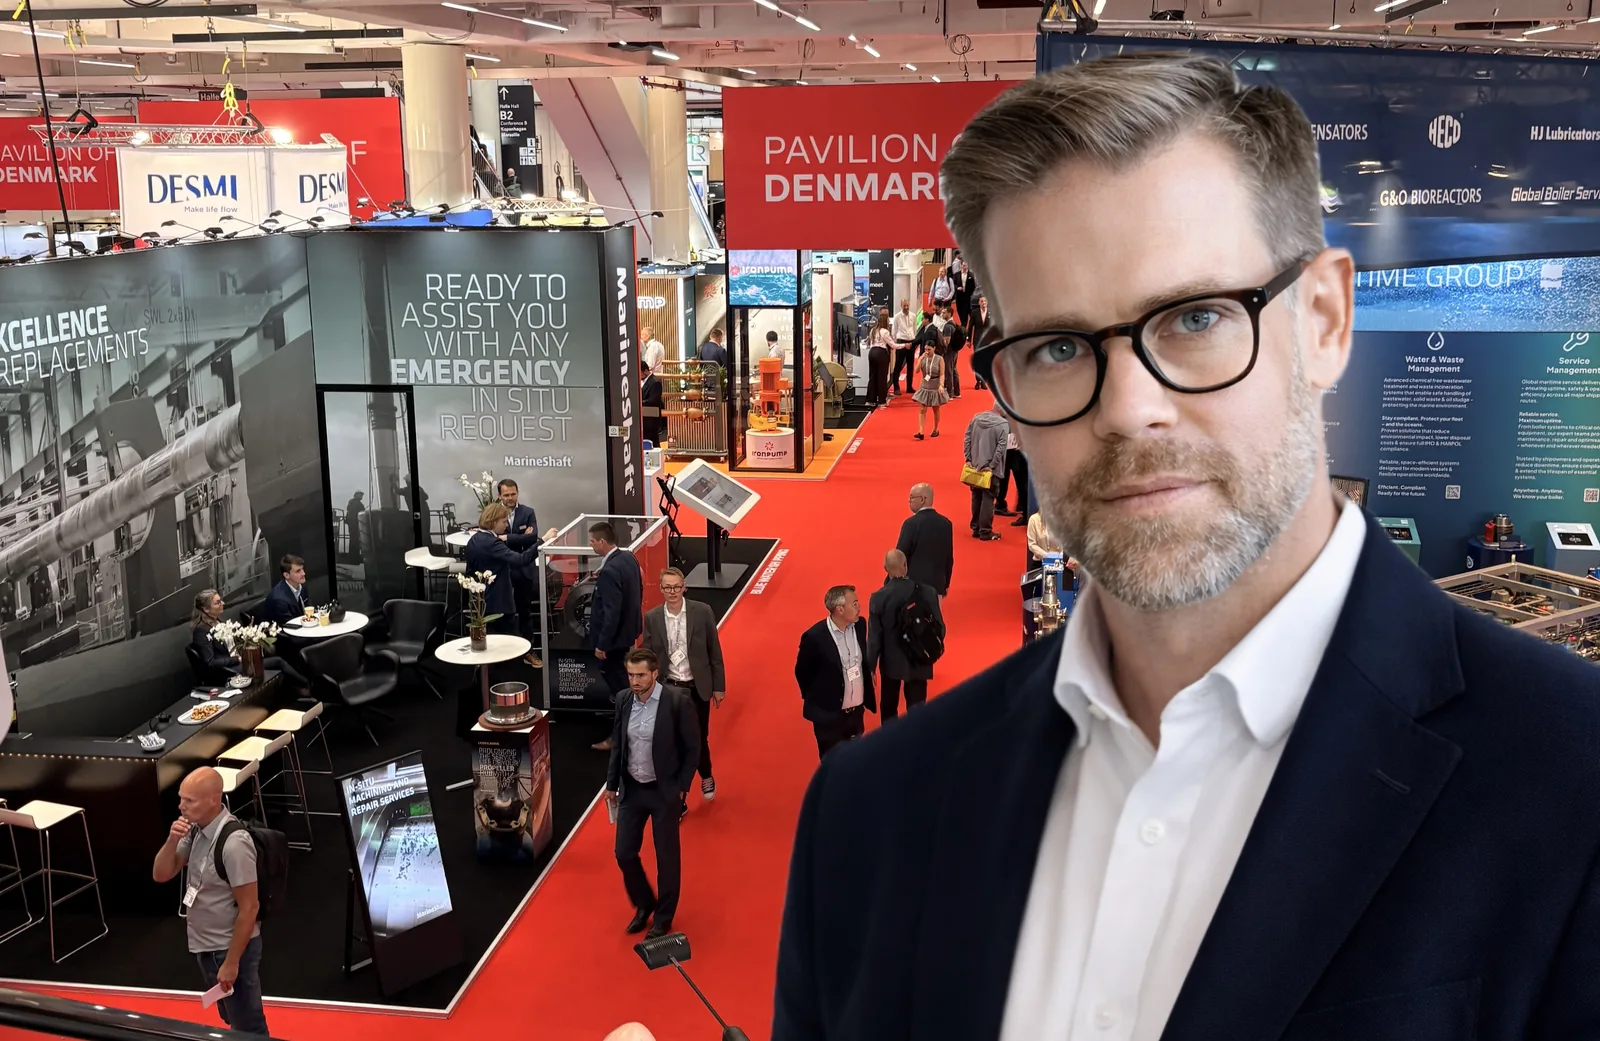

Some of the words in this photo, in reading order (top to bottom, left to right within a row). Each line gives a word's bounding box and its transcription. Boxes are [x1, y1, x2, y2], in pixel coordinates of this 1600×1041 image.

[500, 110, 514, 121] B2
[1530, 126, 1544, 140] HJ
[1546, 126, 1600, 141] Lubricators
[765, 133, 937, 164] PAVILION
[147, 174, 238, 204] DESMI
[1380, 190, 1408, 206] G&O
[1411, 188, 1482, 205] BIOREACTORS
[1511, 187, 1542, 202] Global
[1544, 187, 1574, 201] Boiler
[426, 274, 522, 300] READY
[529, 274, 566, 300] TO
[1426, 264, 1524, 287] GROUP
[401, 302, 500, 328] ASSIST
[508, 303, 567, 329] YOU
[424, 331, 499, 356] WITH
[509, 332, 569, 357] ANY
[391, 358, 570, 385] EMERGENCY
[1408, 365, 1461, 373] Management
[471, 388, 498, 413] IN
[508, 388, 570, 414] SITU
[440, 415, 572, 445] REQUEST
[504, 456, 572, 467] MarineShaft
[346, 776, 375, 794] IN-SITU
[349, 783, 392, 806] MACHINING
[393, 778, 409, 789] AND
[351, 801, 379, 816] REPAIR
[380, 787, 415, 807] SERVICES
